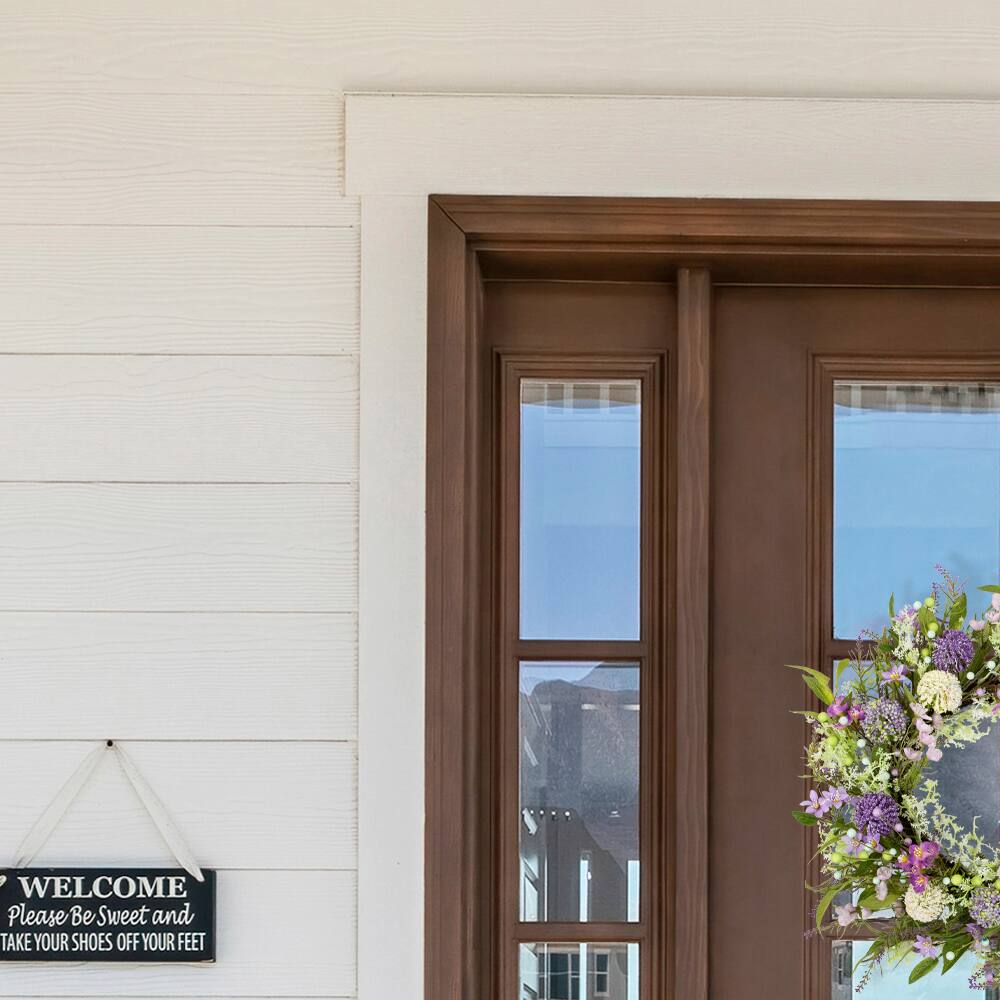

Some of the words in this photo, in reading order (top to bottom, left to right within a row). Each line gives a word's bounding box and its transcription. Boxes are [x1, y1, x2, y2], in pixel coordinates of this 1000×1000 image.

[18, 876, 187, 898] WELCOME
[8, 904, 68, 927] Please
[70, 905, 96, 926] Be
[97, 905, 150, 926] Sweet
[152, 903, 195, 926] and
[0, 932, 32, 951] TAKE
[33, 932, 69, 951] YOUR
[71, 932, 113, 951] SHOES
[117, 932, 140, 951] OFF
[142, 932, 175, 951] YOUR
[178, 932, 206, 951] FEET
